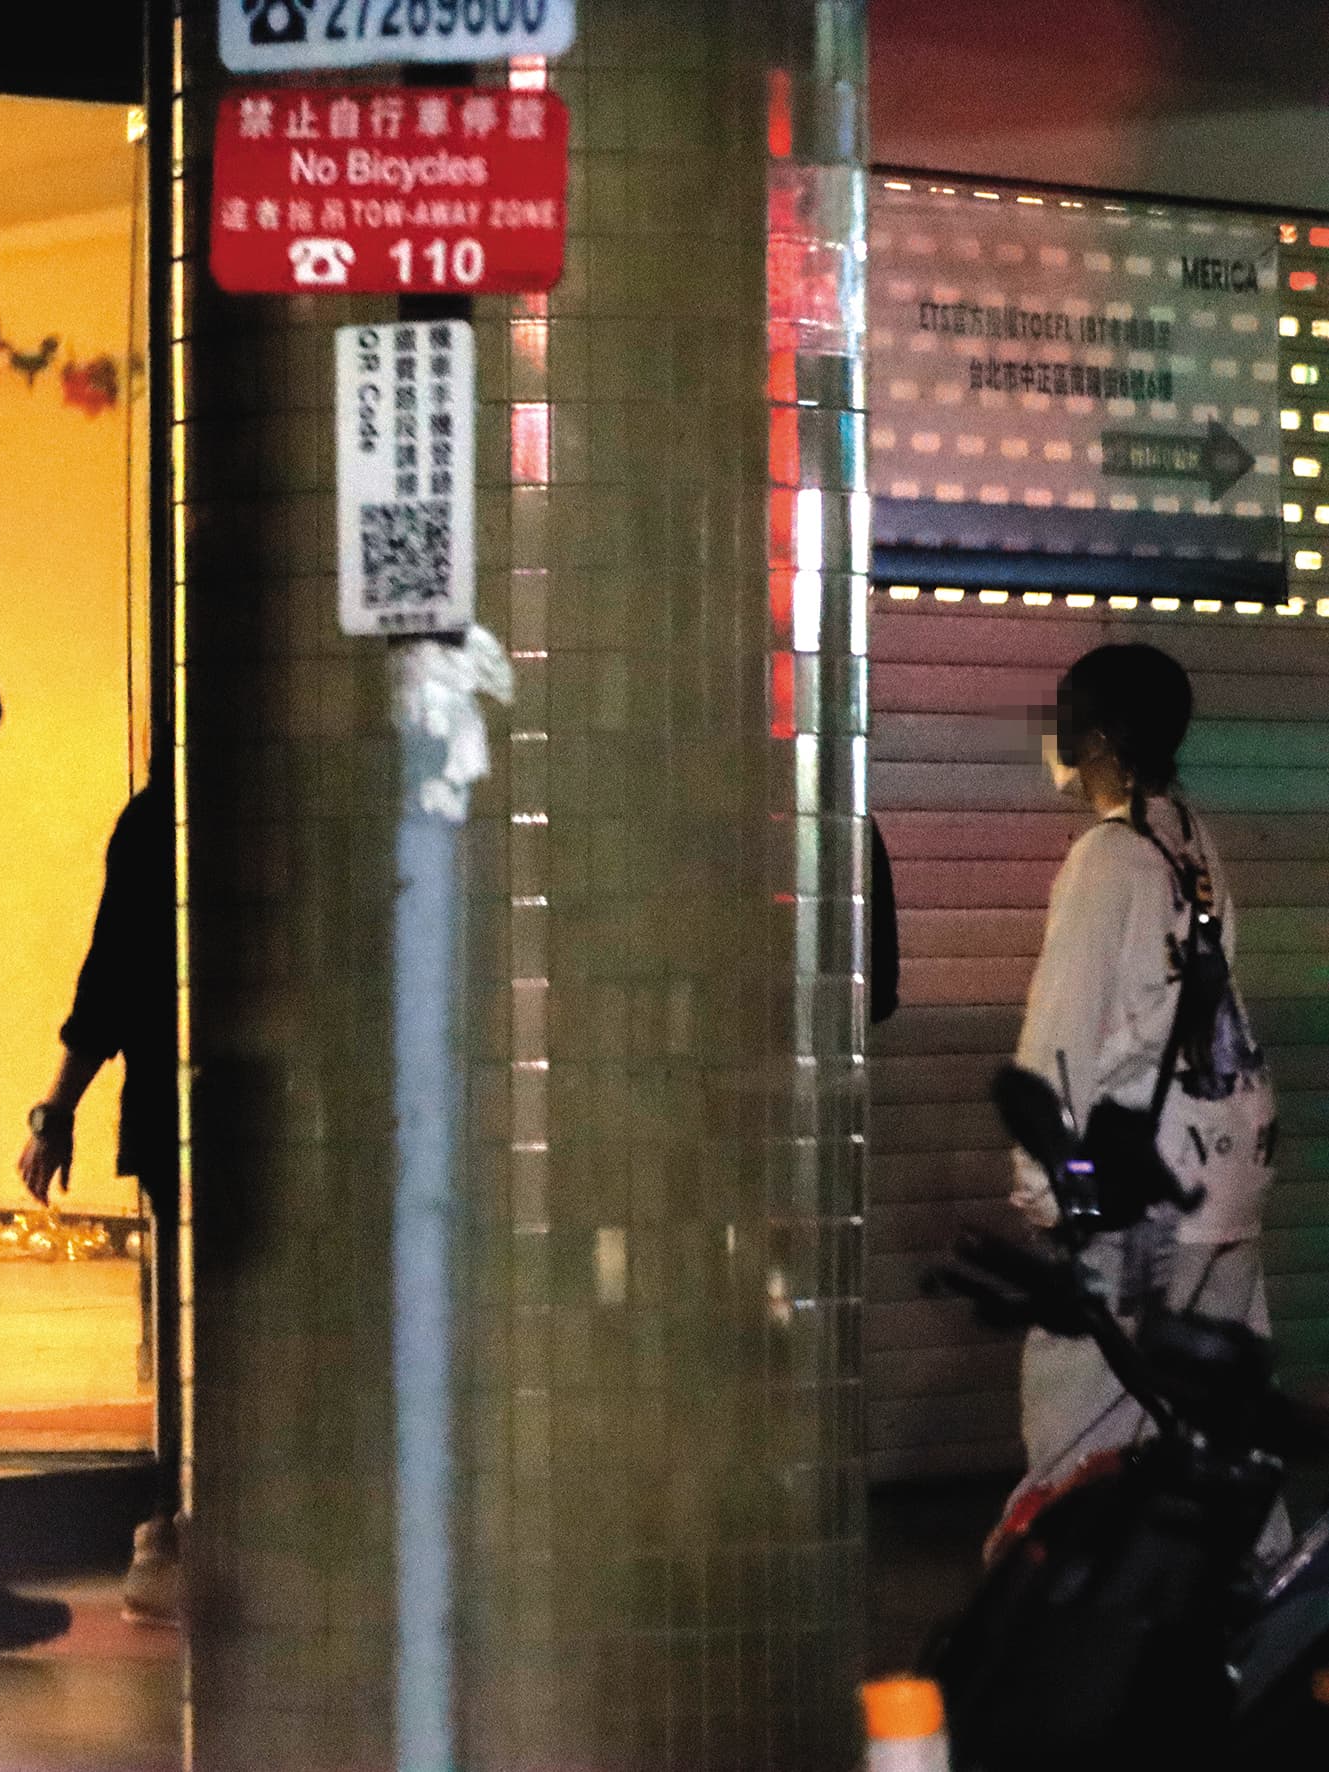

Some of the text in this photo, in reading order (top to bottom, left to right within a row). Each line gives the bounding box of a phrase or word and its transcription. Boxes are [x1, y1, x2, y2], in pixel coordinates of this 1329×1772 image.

[289, 148, 489, 193] No Bicycles
[489, 199, 558, 230] ZONE
[388, 238, 485, 285] 110
[358, 385, 380, 453] Code
